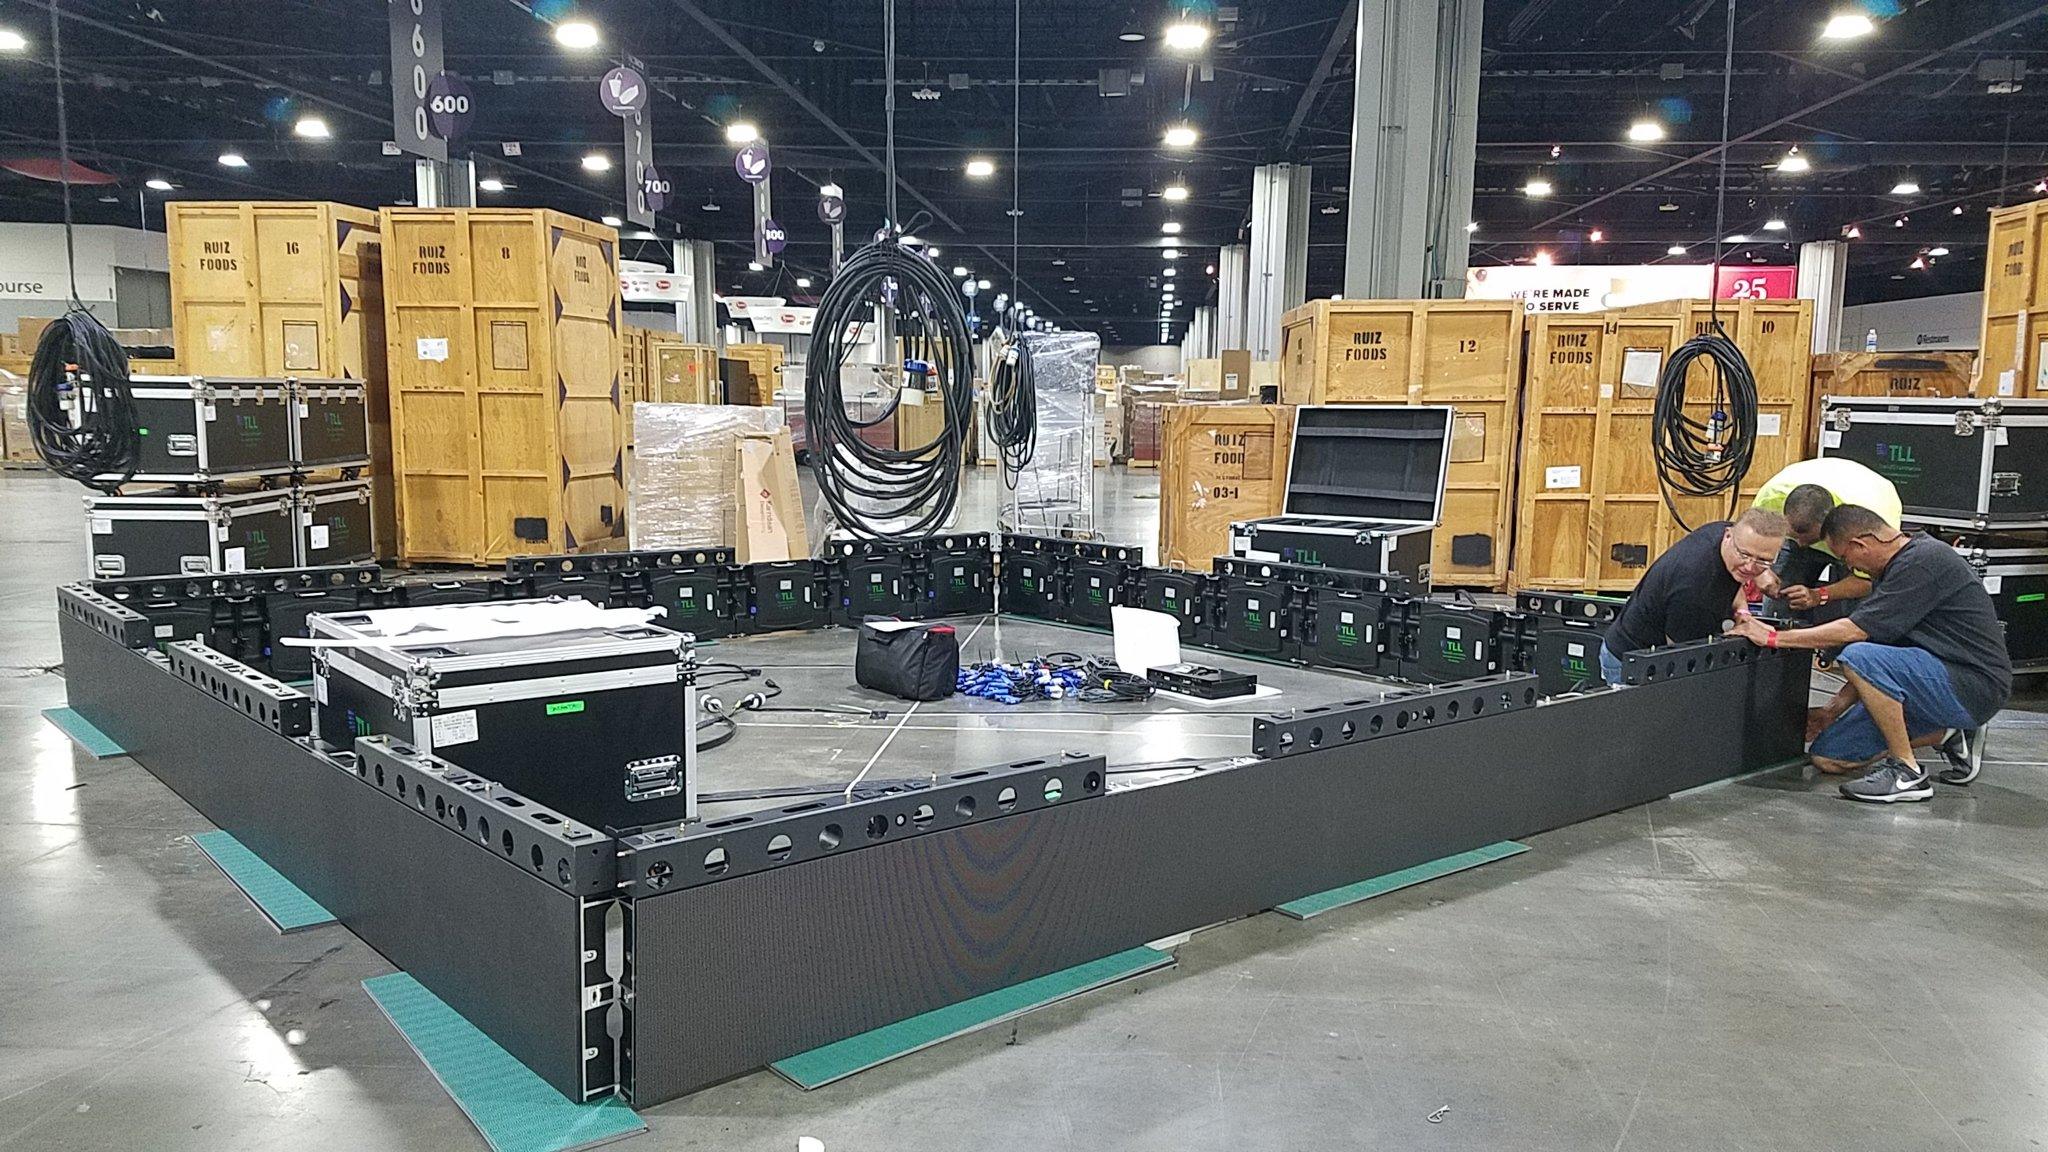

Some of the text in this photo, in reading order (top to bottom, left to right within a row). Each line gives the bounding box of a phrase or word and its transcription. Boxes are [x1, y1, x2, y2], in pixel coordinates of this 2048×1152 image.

[430, 96, 469, 114] 600
[645, 180, 671, 194] 700
[204, 241, 230, 255] RUIZ
[286, 241, 299, 255] 16
[418, 245, 446, 259] RUIZ
[501, 246, 511, 260] 8
[200, 258, 237, 271] FOODS
[412, 261, 451, 275] FOODS
[1553, 288, 1590, 298] MADE
[1731, 277, 1768, 300] 25
[1539, 301, 1580, 311] SERVE
[1604, 321, 1618, 335] 14
[1761, 320, 1775, 333] 10
[1353, 331, 1382, 345] RUIZ
[1556, 333, 1588, 347] RUIZ
[1459, 339, 1477, 354] 12
[1345, 347, 1387, 361] FOODS
[1549, 351, 1593, 364] FOODS
[1890, 377, 1921, 391] RUIZ
[244, 415, 258, 430] TLL
[1214, 432, 1246, 447] RUIZ
[1888, 444, 1916, 463] TLL
[1212, 486, 1240, 499] 03-1
[253, 530, 267, 543] TLL
[1295, 549, 1321, 565] TLL
[871, 584, 886, 594] TLL
[681, 600, 696, 609] TLL
[1341, 625, 1356, 637] TLL
[1447, 641, 1464, 653] TLL
[1568, 659, 1588, 672] TLL
